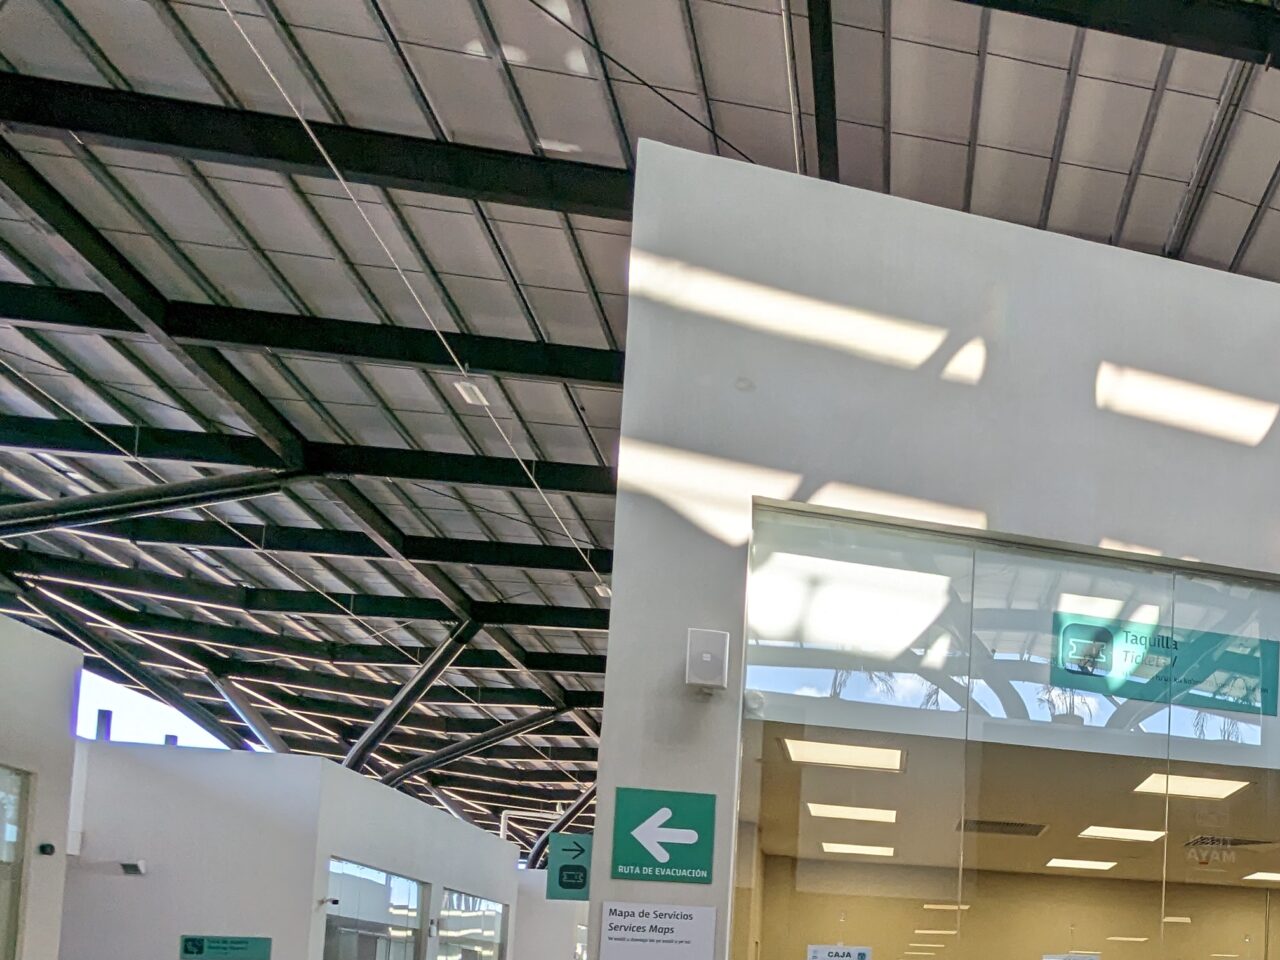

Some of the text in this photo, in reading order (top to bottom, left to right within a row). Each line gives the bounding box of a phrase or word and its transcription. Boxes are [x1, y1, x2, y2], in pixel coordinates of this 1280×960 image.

[1123, 630, 1178, 651] Taquilla
[618, 865, 708, 878] RUTA DE EVACUACIÓN
[608, 908, 694, 921] Mapa de Servicios
[608, 922, 675, 936] Services Maps
[827, 951, 852, 959] CAJA
